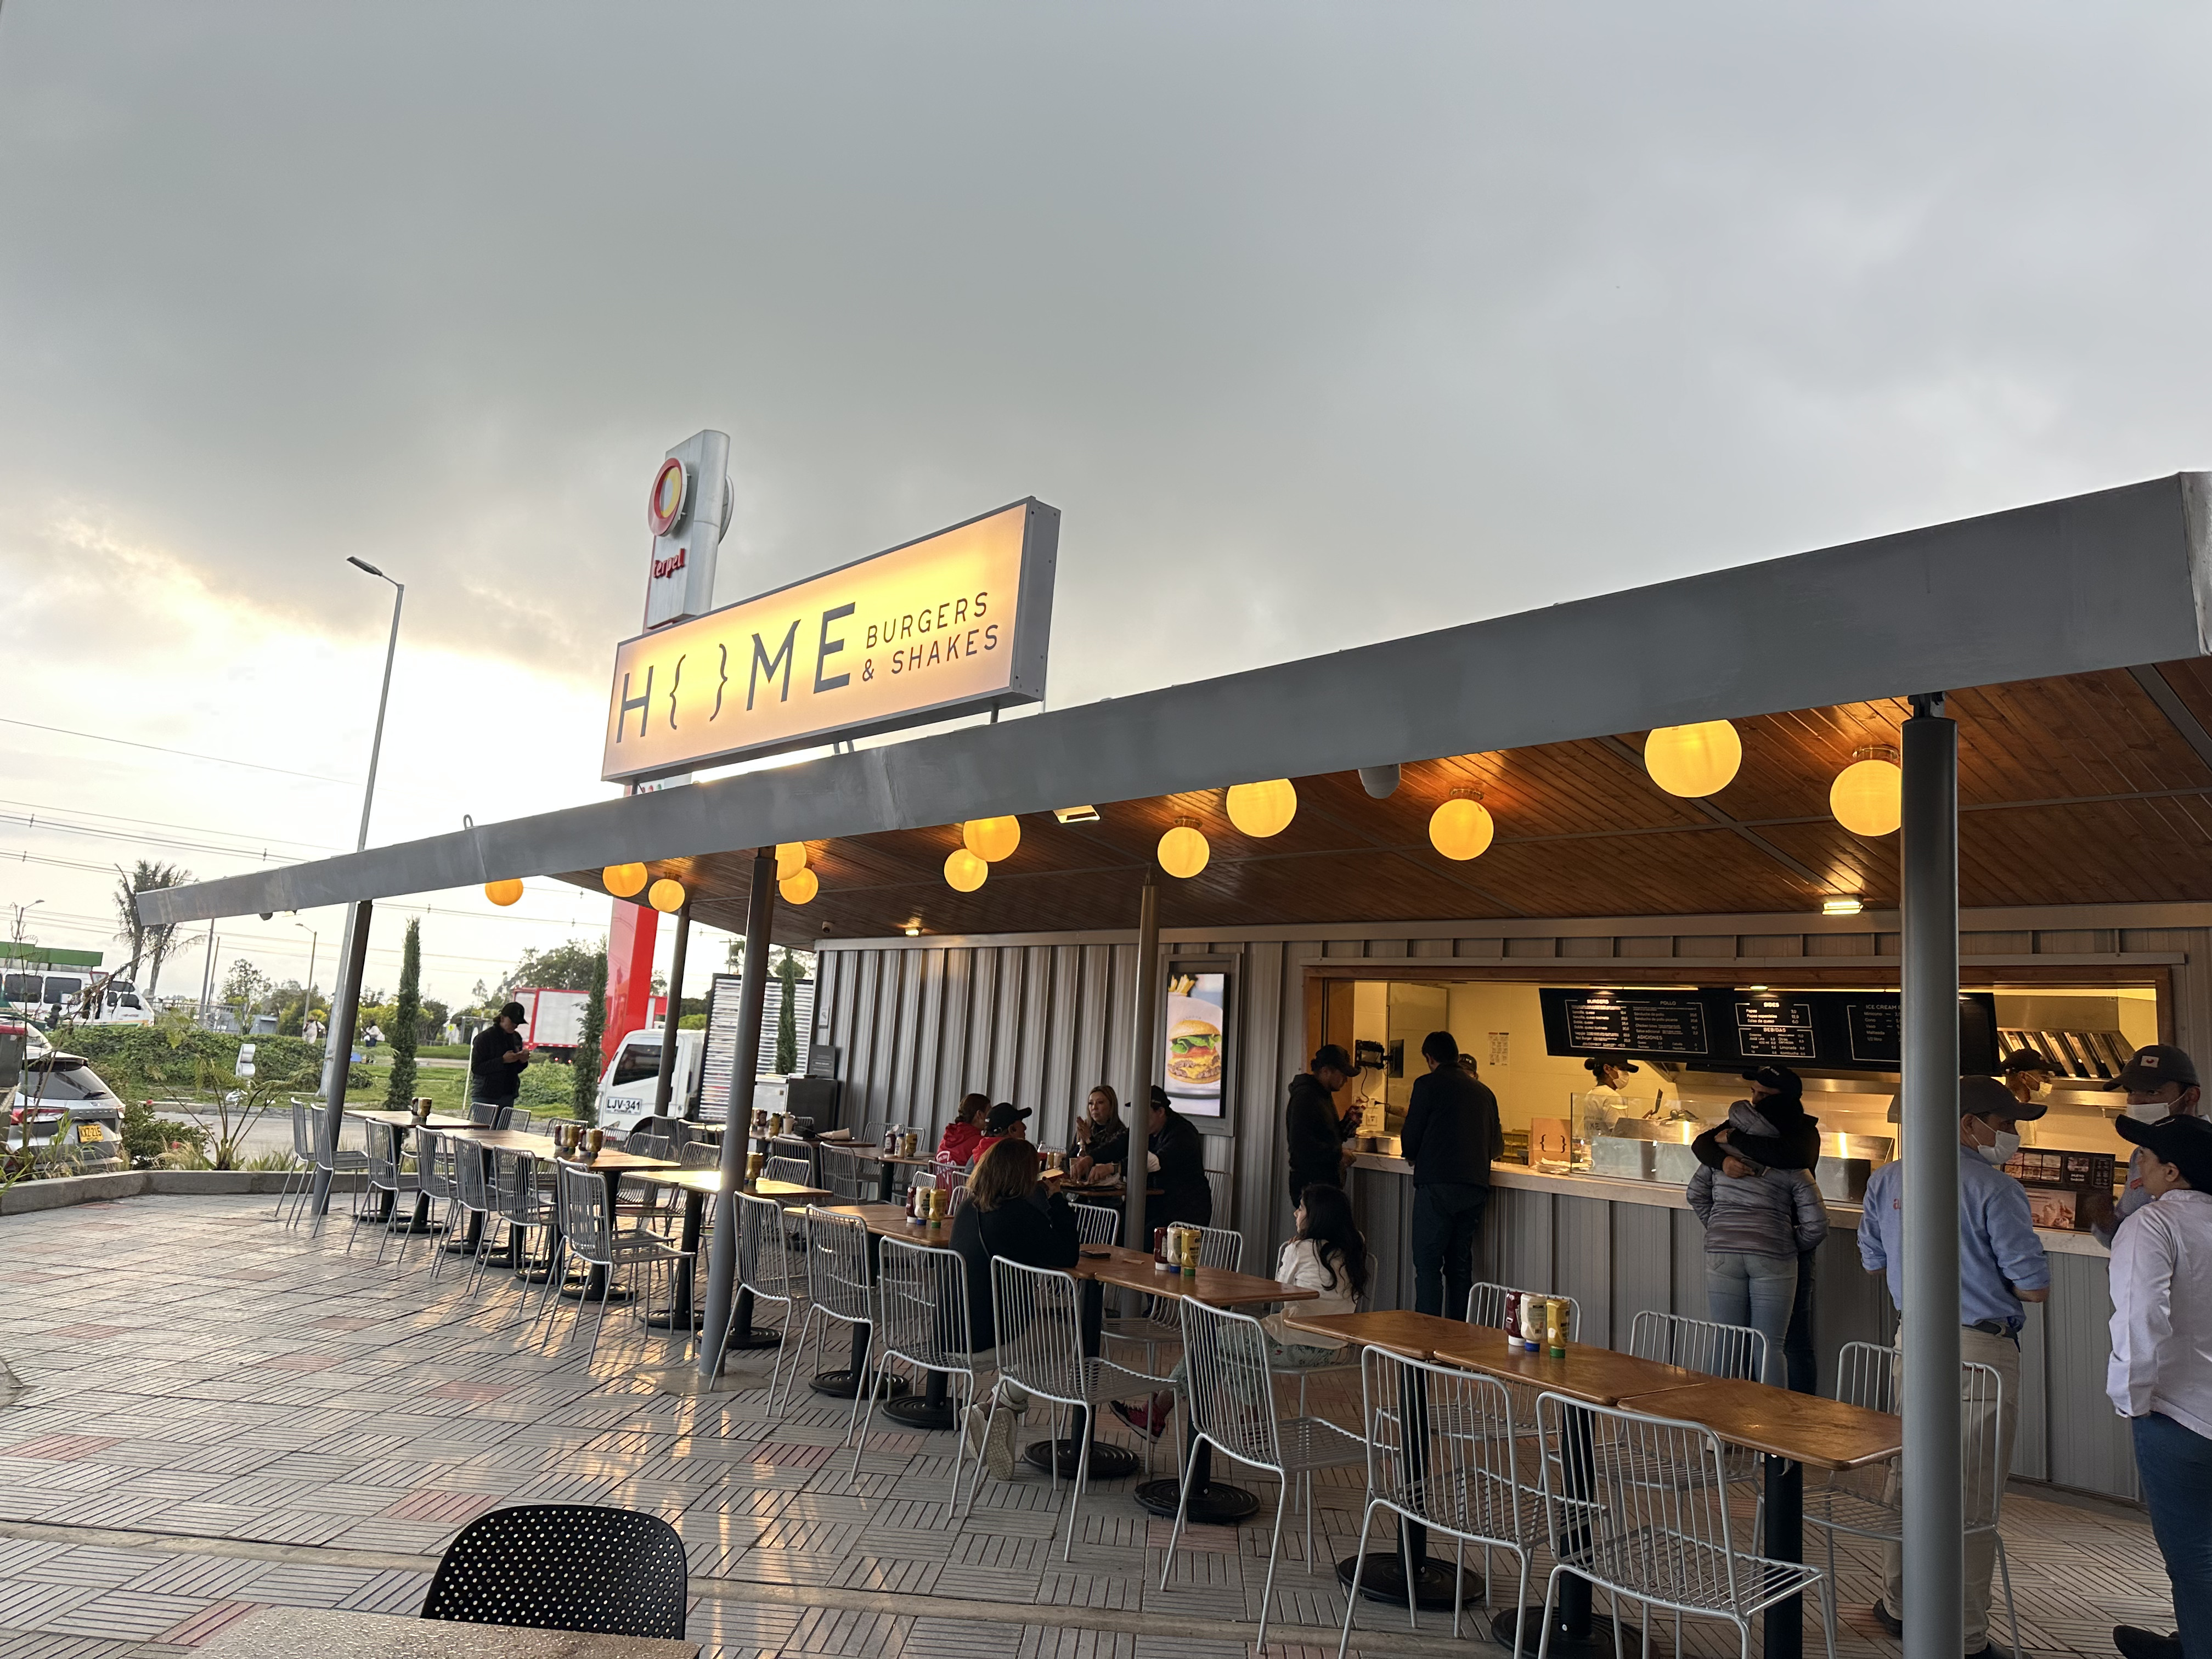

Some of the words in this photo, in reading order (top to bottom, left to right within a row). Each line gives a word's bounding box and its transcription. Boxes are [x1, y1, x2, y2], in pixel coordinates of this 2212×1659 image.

[653, 548, 685, 579] terpel
[865, 591, 989, 650] BURGERS
[861, 658, 874, 682] &
[891, 624, 999, 674] SHAKES
